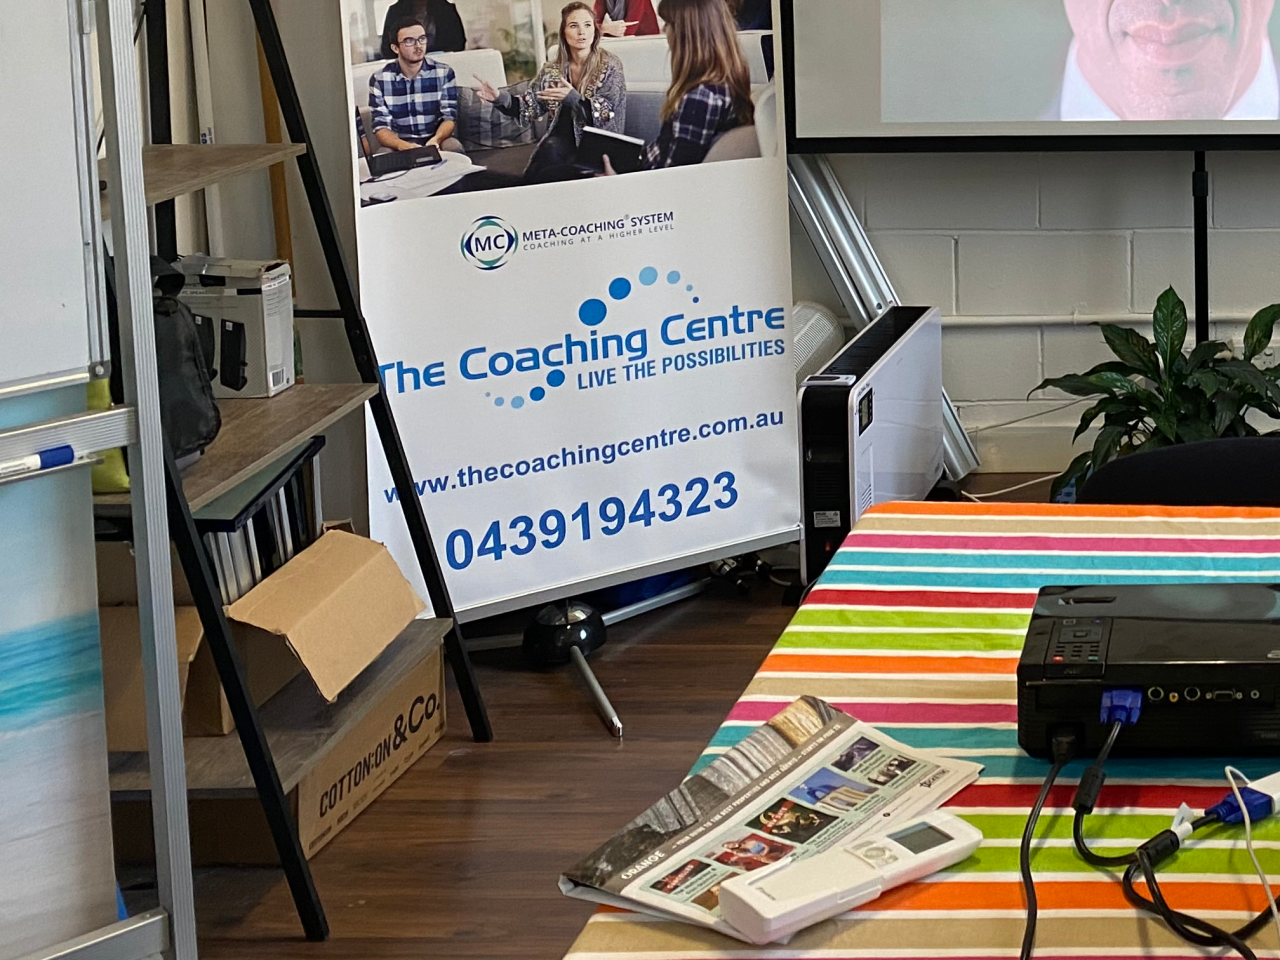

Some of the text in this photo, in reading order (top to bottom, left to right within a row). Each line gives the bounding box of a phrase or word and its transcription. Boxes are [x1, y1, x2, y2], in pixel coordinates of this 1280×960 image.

[523, 238, 574, 251] COACHING
[580, 236, 591, 244] AT
[609, 229, 644, 240] HIGHER
[648, 223, 675, 234] LEVEL
[630, 211, 674, 227] SYSTEM
[474, 234, 505, 252] MC
[459, 328, 648, 381] Coaching
[660, 304, 785, 347] Centre
[577, 338, 786, 390] LIVE THE POSSIBILITIES
[445, 470, 740, 571] 0439194323
